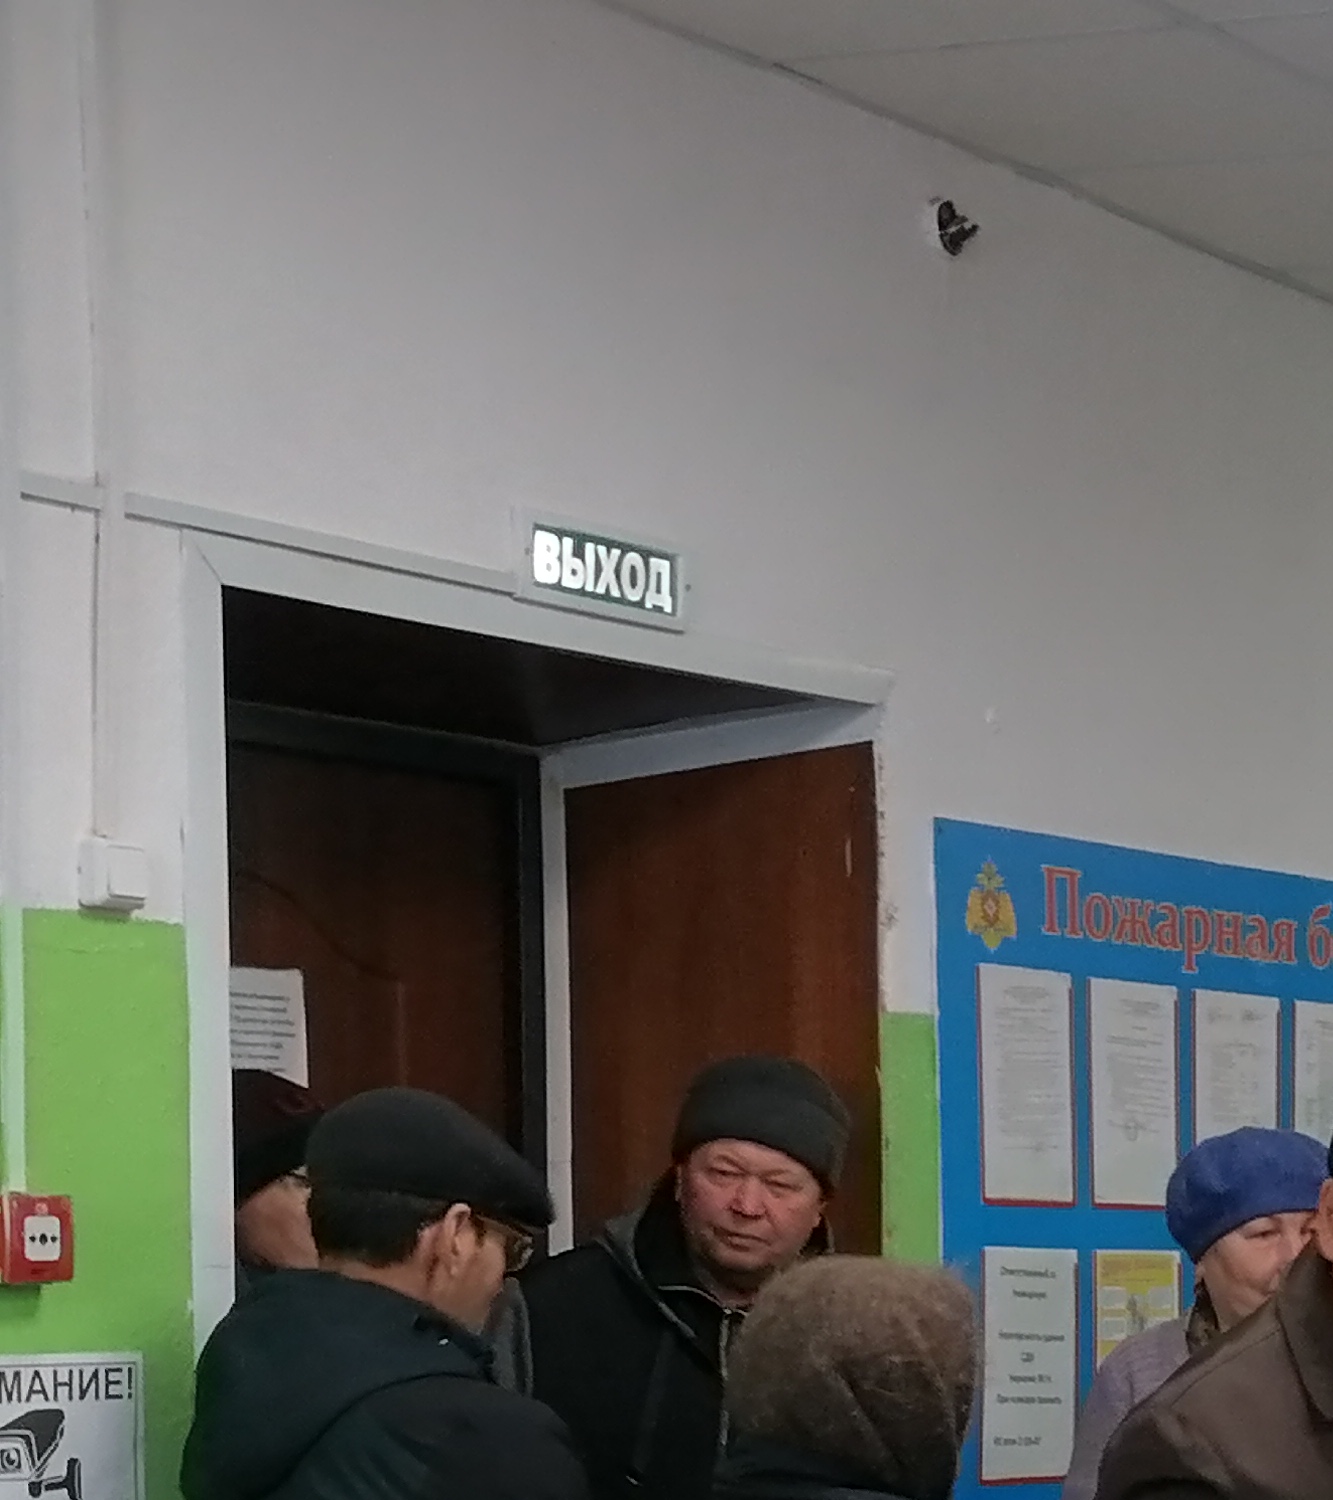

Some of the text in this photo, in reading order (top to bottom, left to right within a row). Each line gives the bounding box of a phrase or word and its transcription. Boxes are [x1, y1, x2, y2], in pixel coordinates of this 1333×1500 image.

[533, 529, 673, 614] ВЫХОД
[1041, 864, 1297, 974] Пожарная
[0, 1366, 133, 1404] МАНИЕ!
